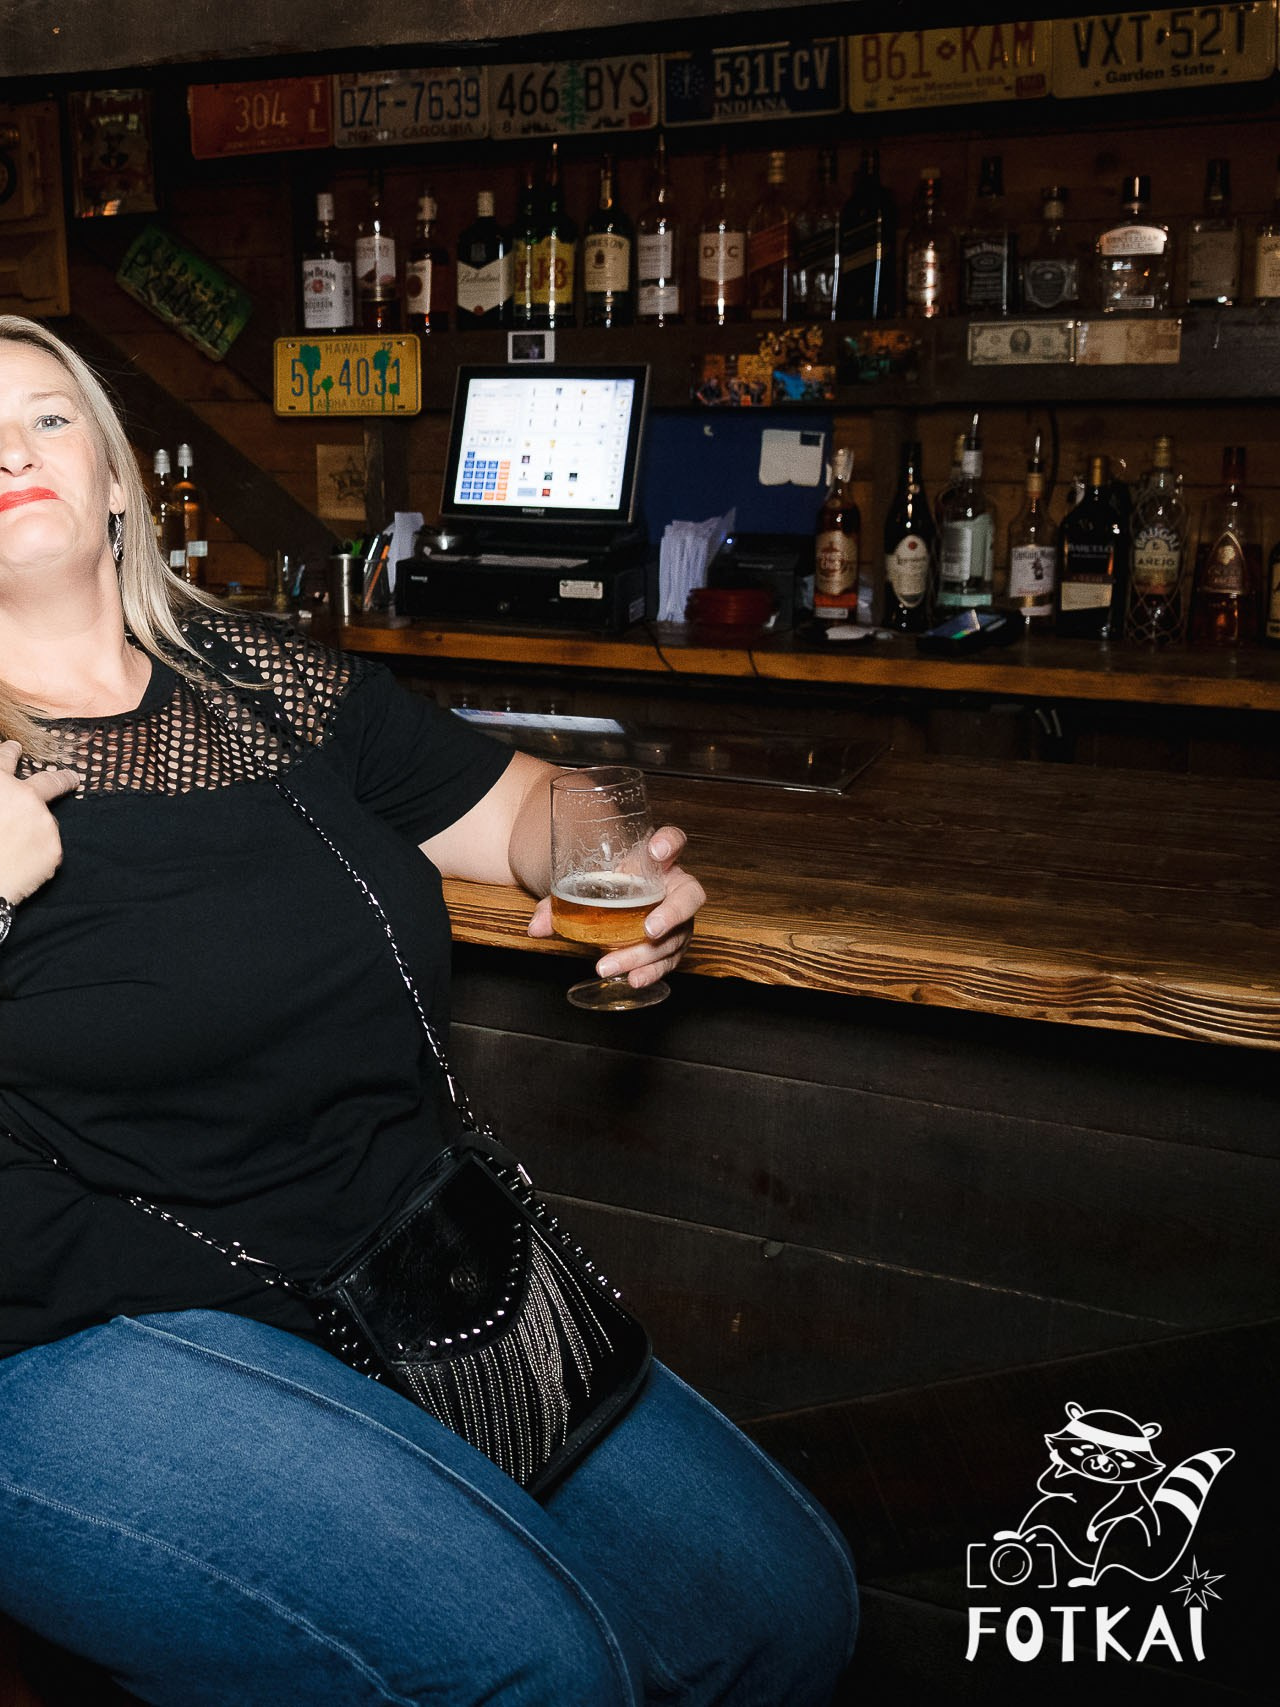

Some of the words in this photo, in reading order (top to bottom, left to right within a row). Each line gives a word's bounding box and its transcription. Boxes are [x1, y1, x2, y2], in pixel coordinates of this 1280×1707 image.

[1073, 14, 1151, 68] VXT
[1170, 2, 1255, 59] 52T
[714, 46, 830, 98] 531FCV
[1106, 68, 1165, 84] Garden
[1170, 62, 1215, 78] State
[498, 70, 559, 117] 466
[584, 62, 649, 111] BYS
[234, 92, 289, 133] 304
[713, 97, 789, 116] INDIANA
[402, 122, 474, 137] CAROLINA
[325, 343, 368, 354] HAWAII
